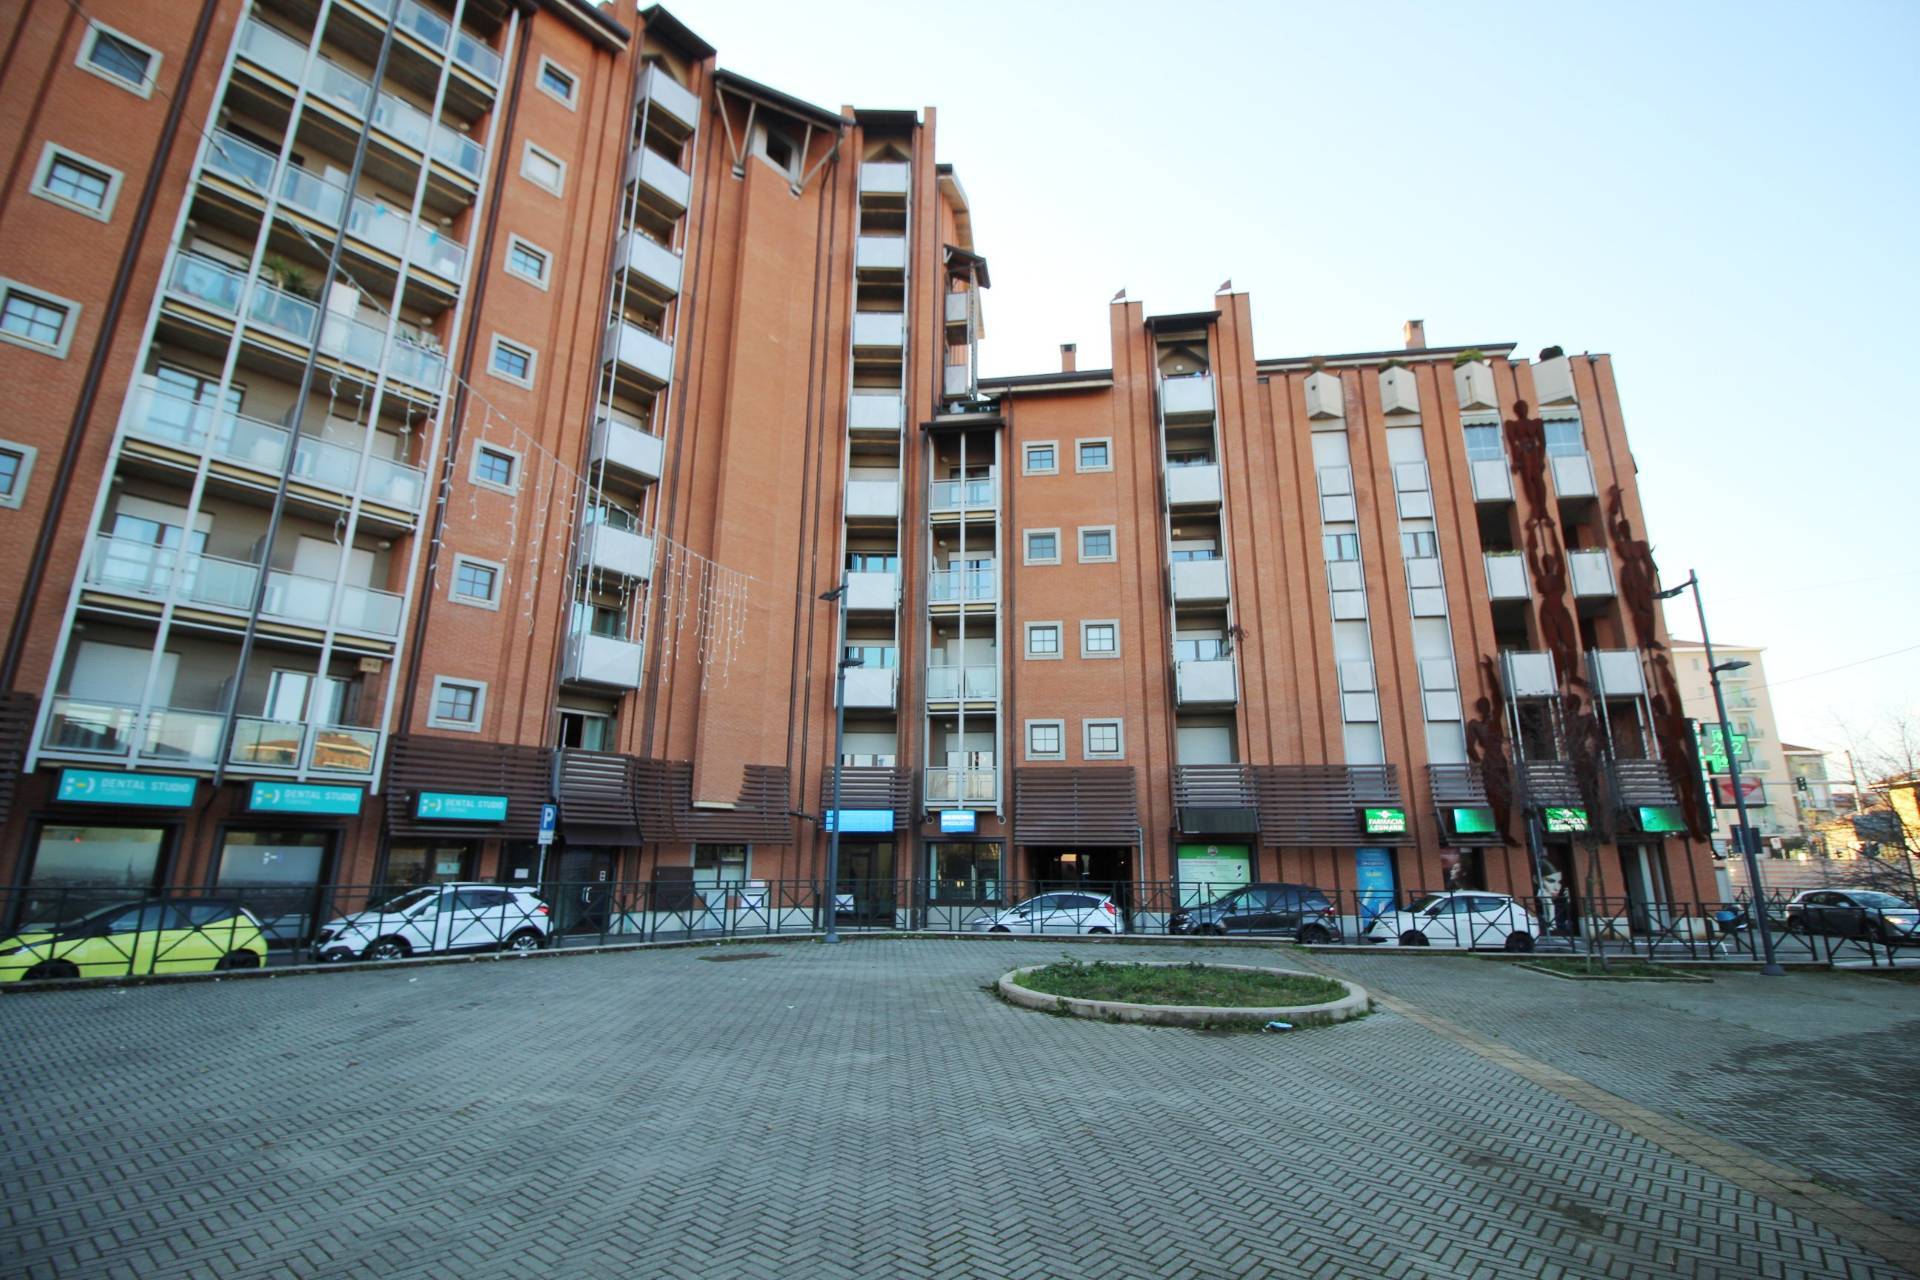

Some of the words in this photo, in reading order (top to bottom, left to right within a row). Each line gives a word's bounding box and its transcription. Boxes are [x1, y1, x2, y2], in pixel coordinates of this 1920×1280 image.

[101, 778, 145, 790] DENTAL
[151, 781, 191, 793] STUDIO
[284, 789, 321, 800] DENTAL
[324, 791, 357, 802] STUDIO
[445, 798, 475, 808] DENTAL
[478, 800, 504, 810] STUDIO
[543, 807, 554, 829] P
